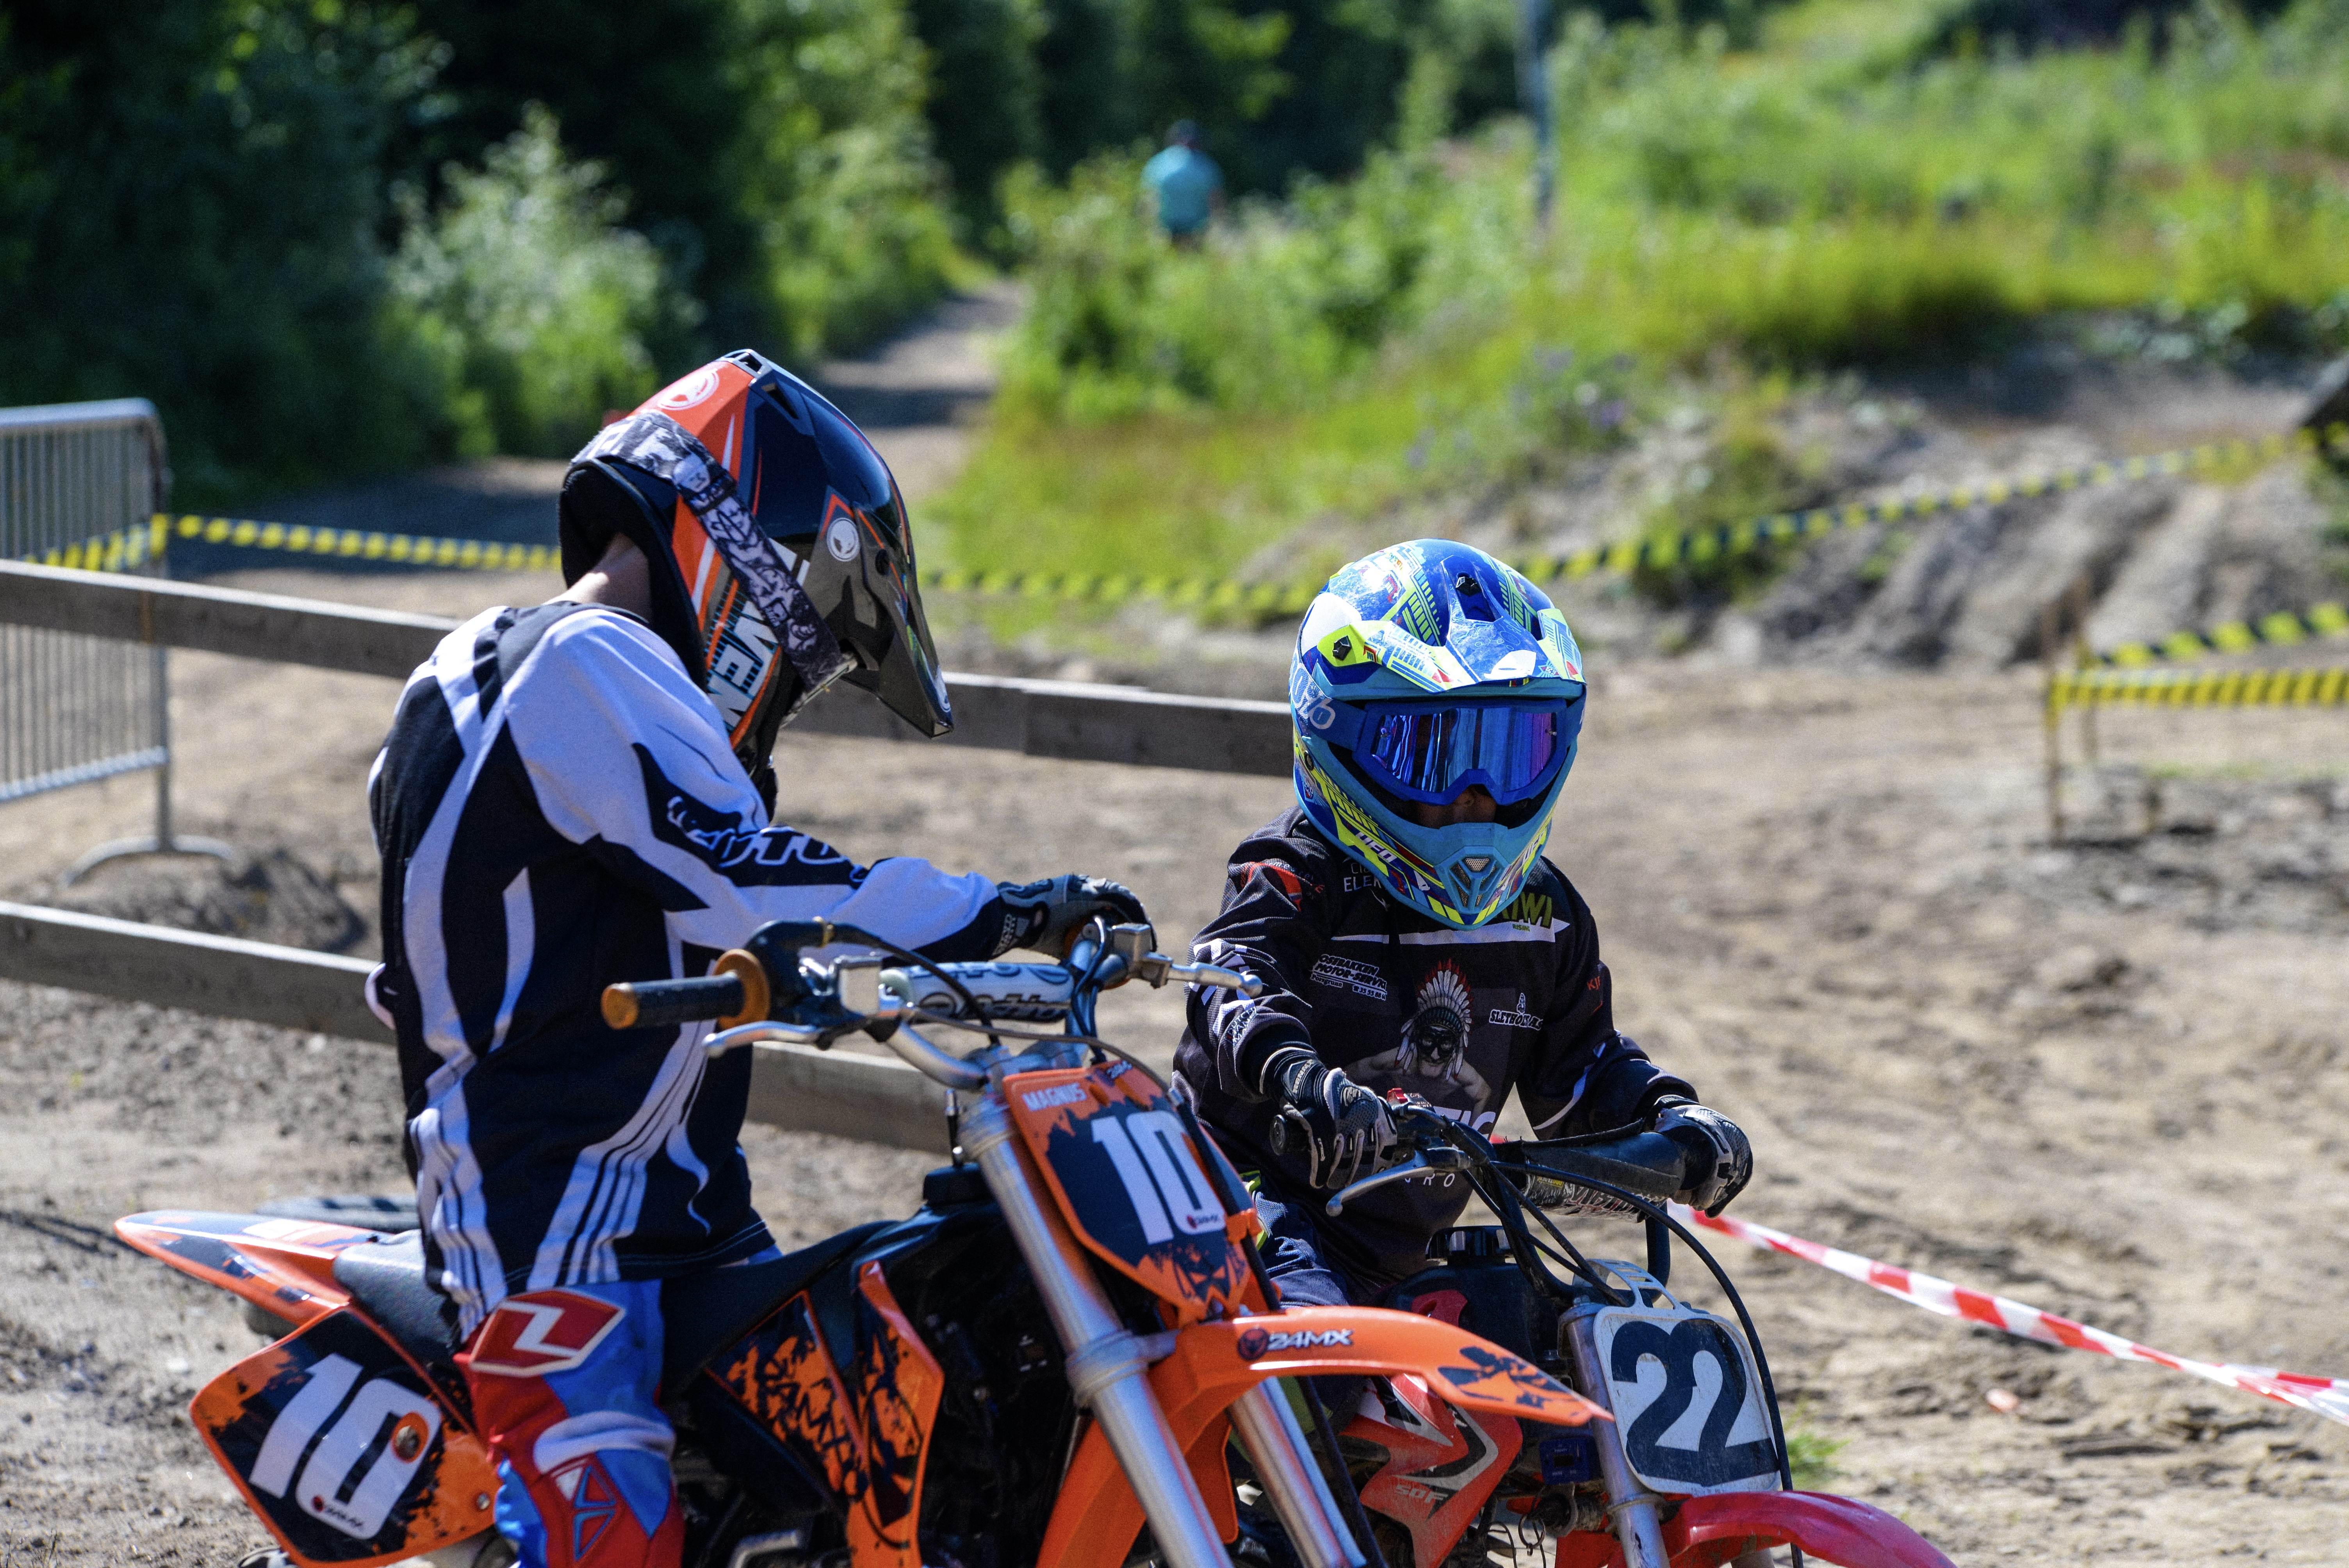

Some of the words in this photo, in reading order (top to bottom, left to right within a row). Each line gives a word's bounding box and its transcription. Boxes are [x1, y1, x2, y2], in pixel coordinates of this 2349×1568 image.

[1356, 832, 1397, 862] UFO
[1500, 891, 1552, 929] IWI
[1022, 1082, 1087, 1112] MAGNUS
[1091, 1110, 1226, 1245] 10
[1267, 1328, 1354, 1351] 24MX
[1611, 1319, 1780, 1487] 22
[248, 1353, 441, 1540] 10
